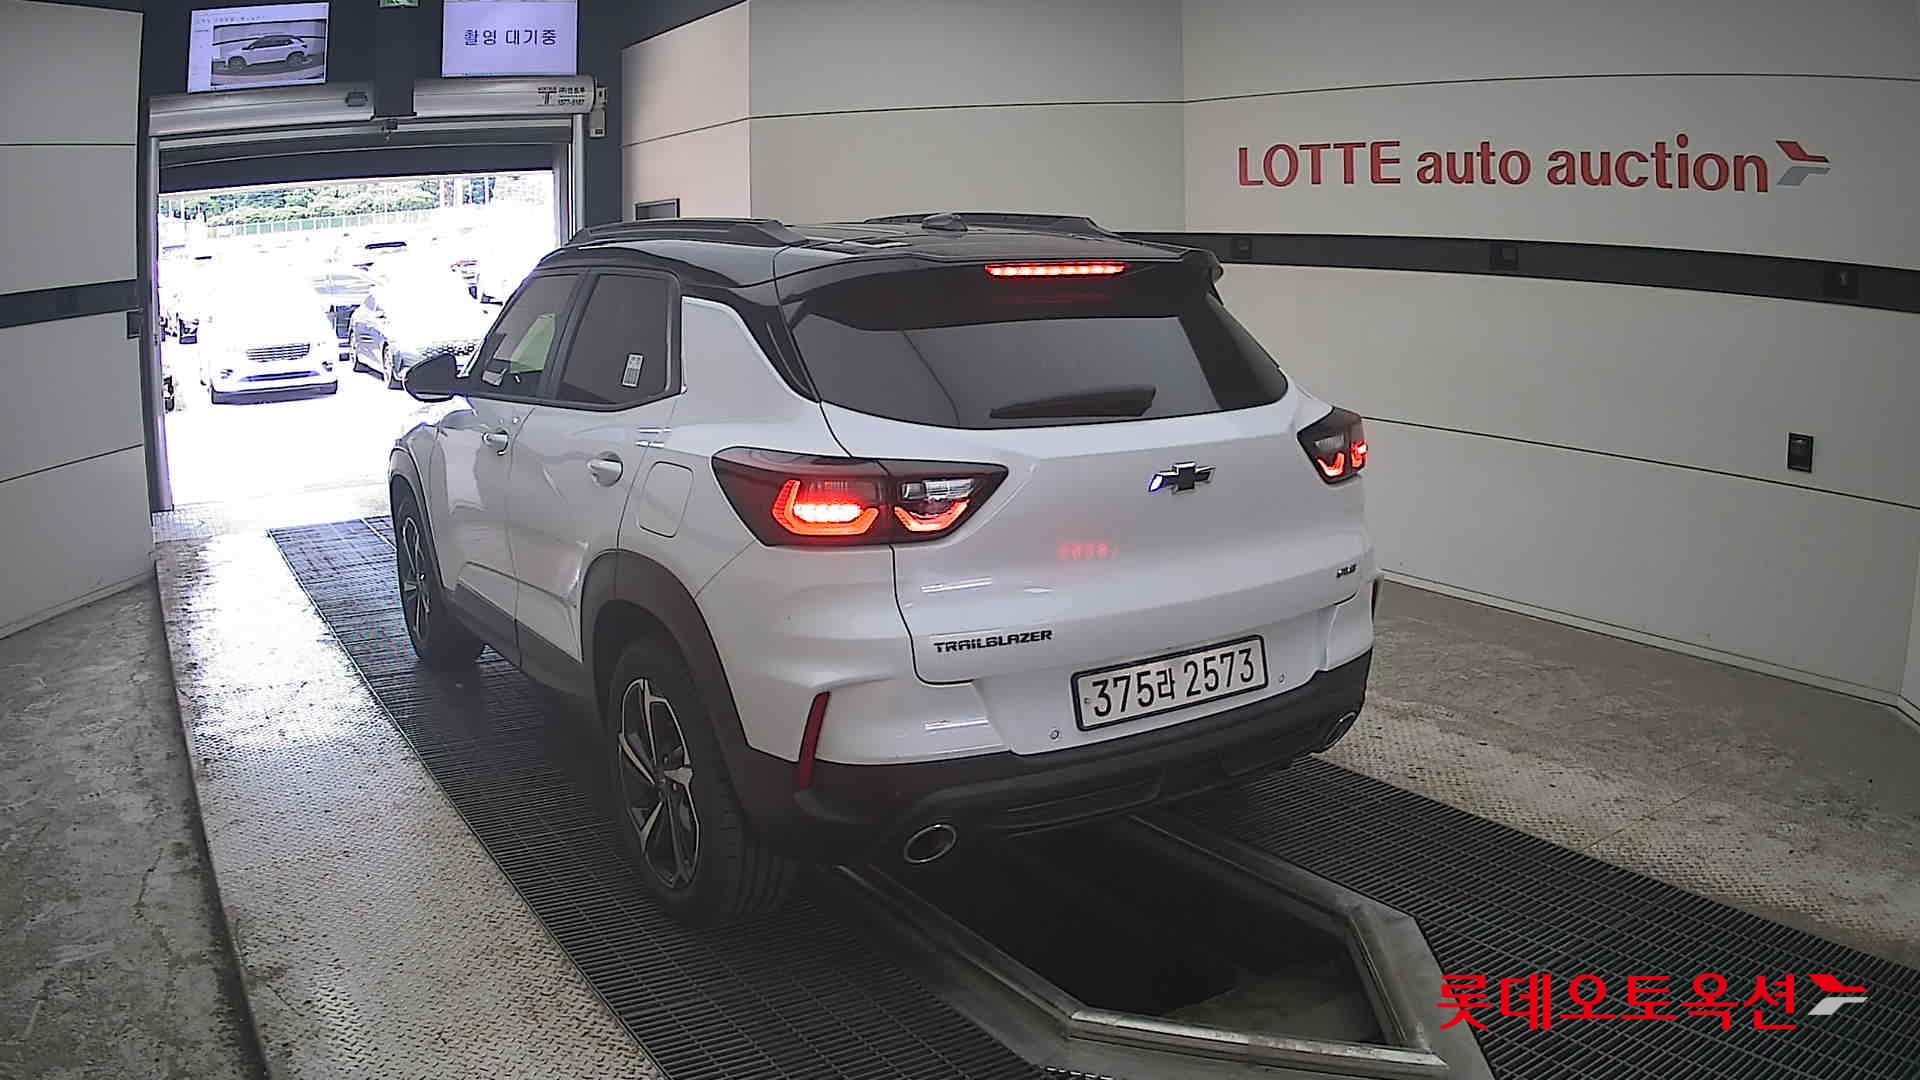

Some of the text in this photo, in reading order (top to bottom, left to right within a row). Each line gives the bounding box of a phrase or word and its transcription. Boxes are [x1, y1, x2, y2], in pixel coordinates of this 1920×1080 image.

[464, 29, 557, 46] 촬영 대기중
[1238, 133, 1768, 193] LOTTE auto auction
[933, 630, 1052, 653] TRAILBLAZER
[1092, 648, 1255, 717] 375라 2573
